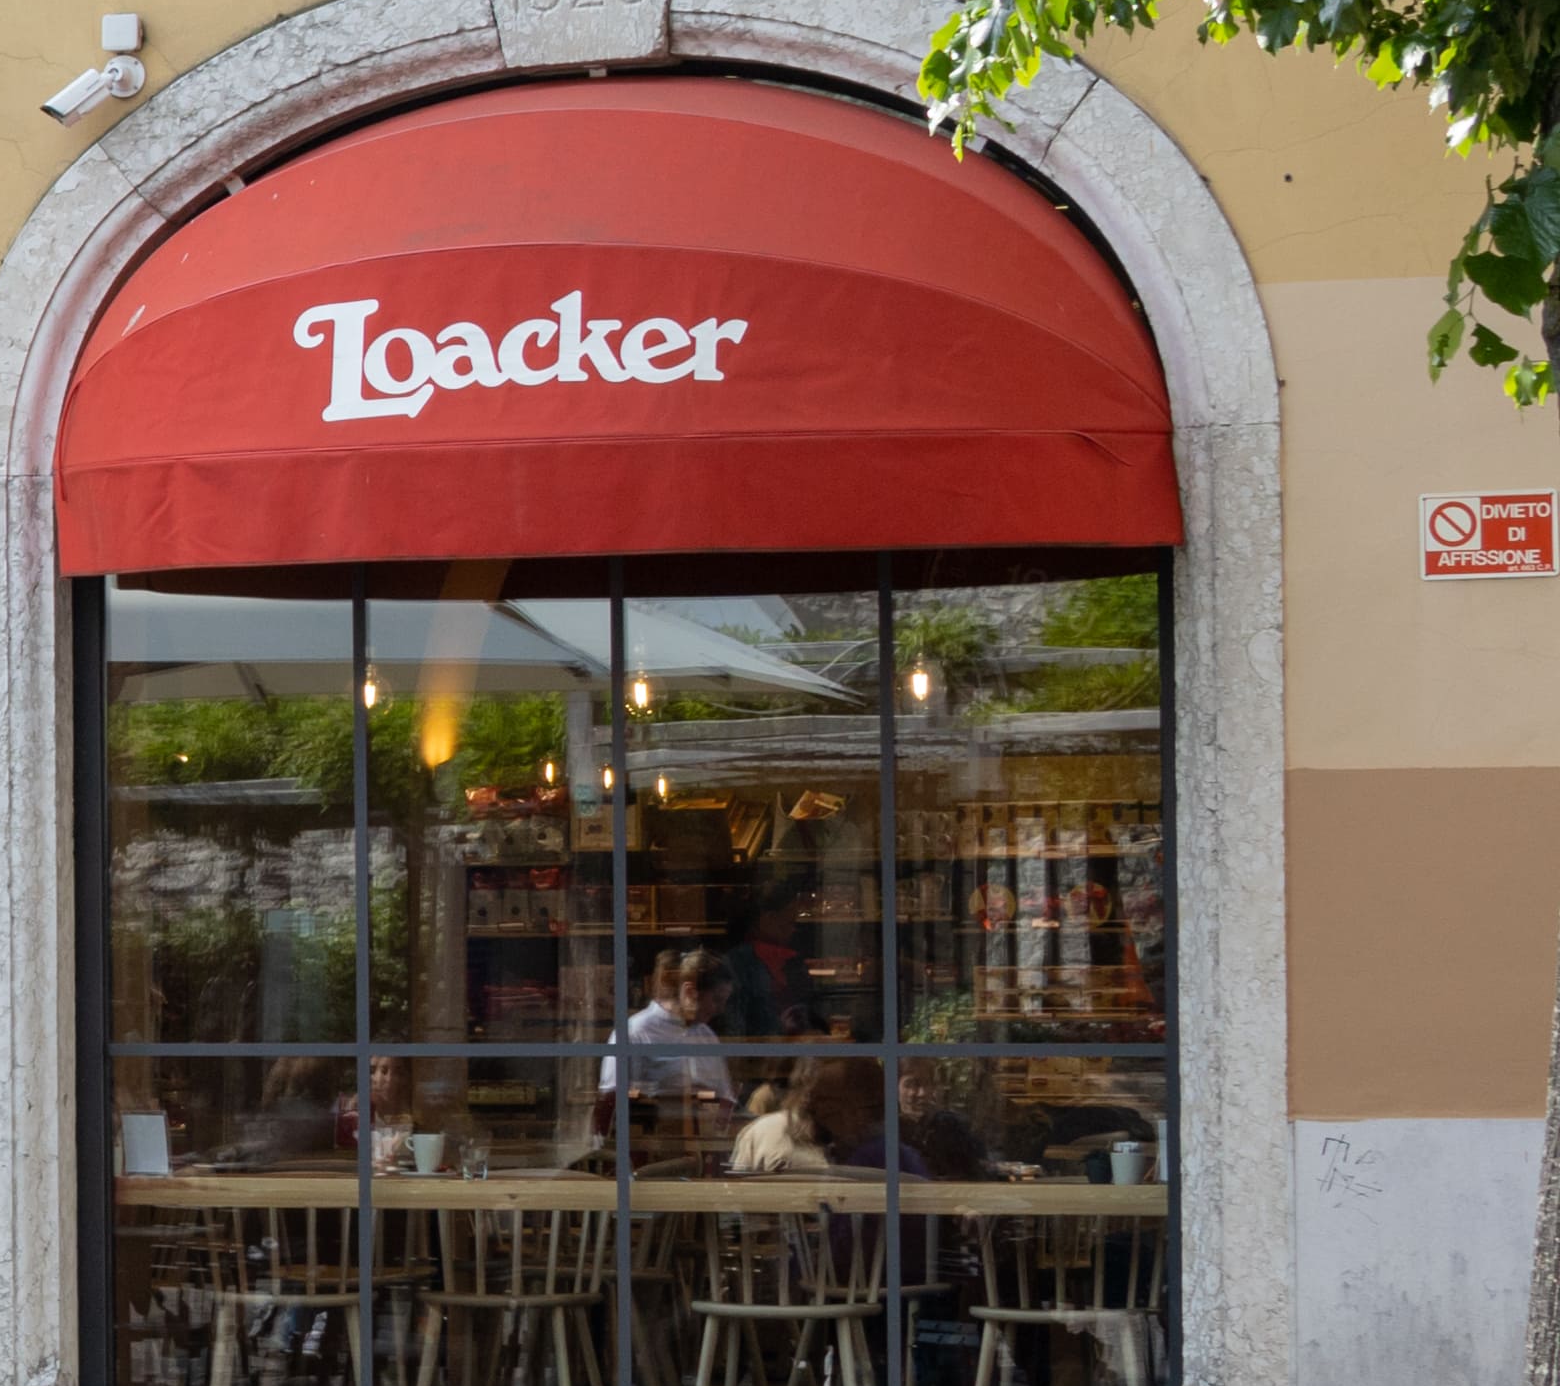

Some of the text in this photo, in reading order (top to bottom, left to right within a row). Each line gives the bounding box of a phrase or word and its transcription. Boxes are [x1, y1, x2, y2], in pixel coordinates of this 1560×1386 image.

[293, 290, 748, 422] Loacker
[1481, 502, 1551, 519] DIVIETO
[1507, 527, 1526, 542] DI
[1437, 549, 1541, 567] AFFISSIONE
